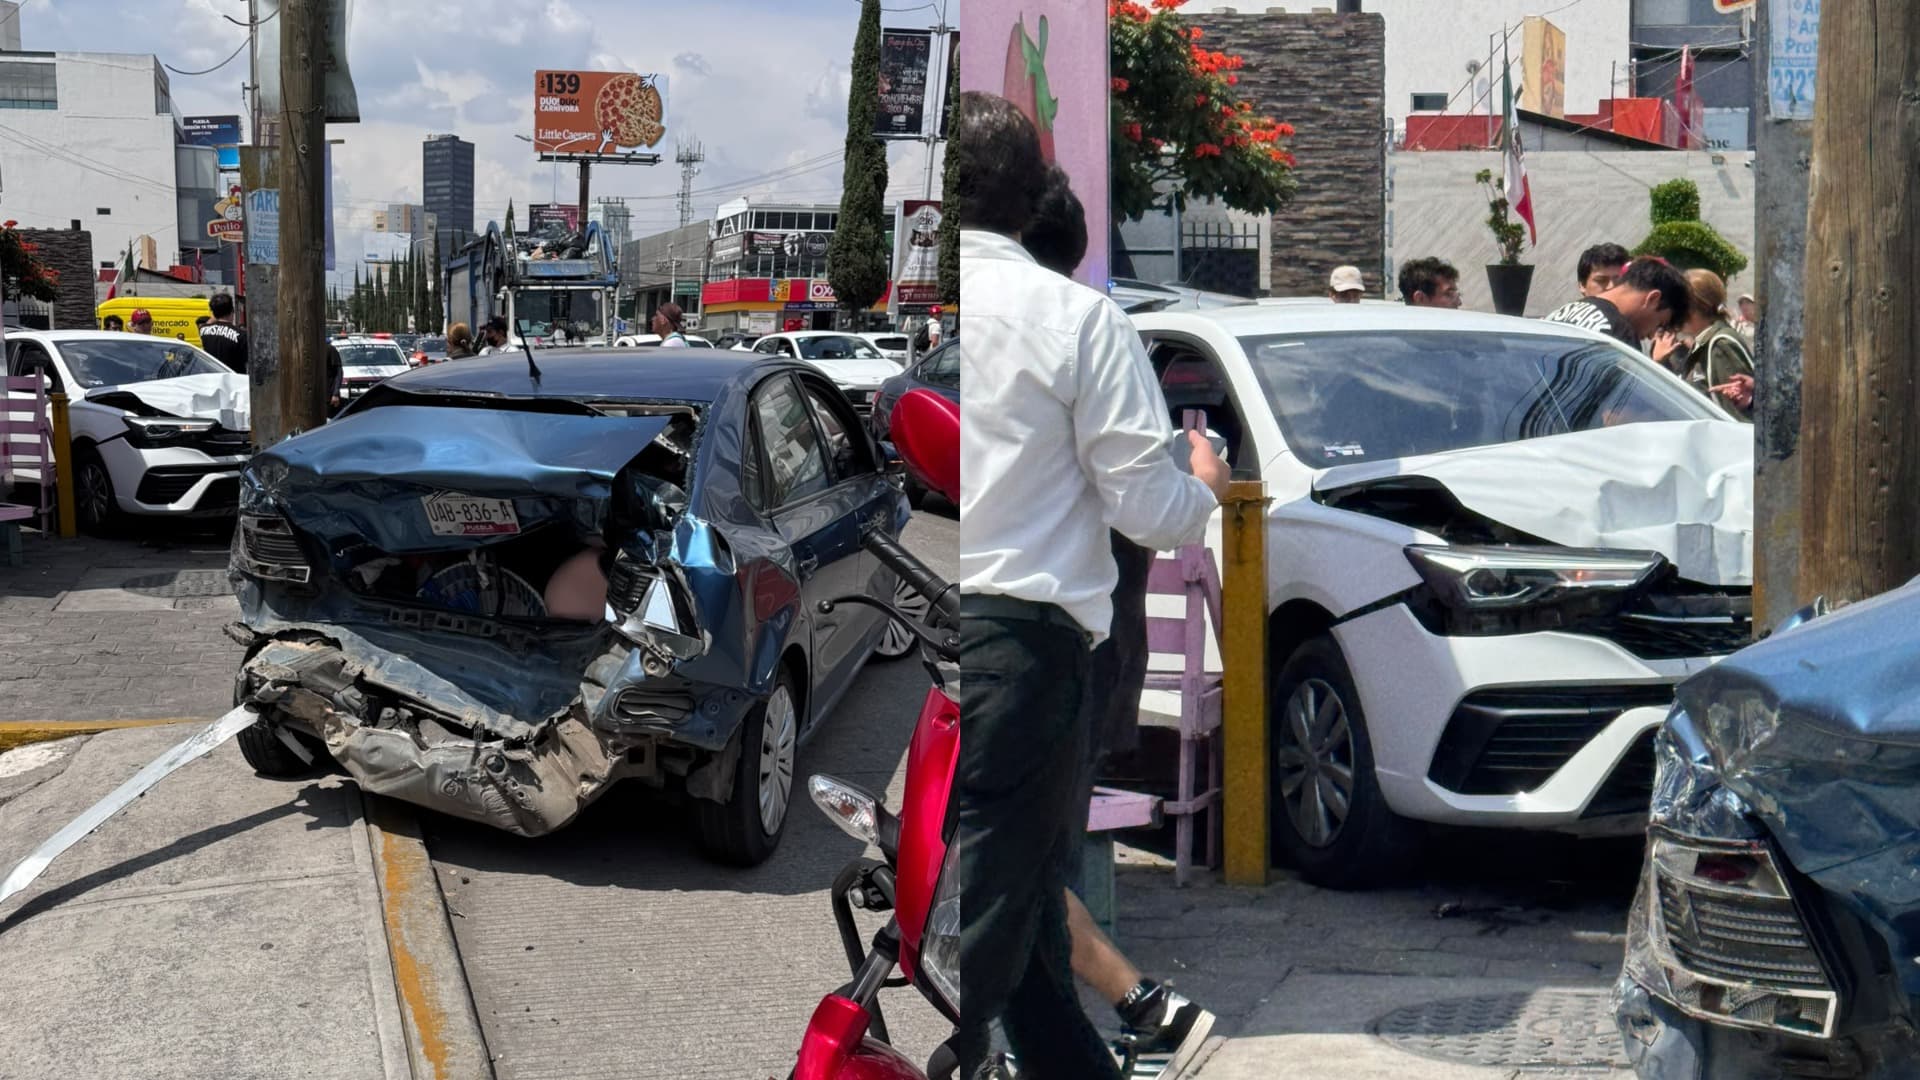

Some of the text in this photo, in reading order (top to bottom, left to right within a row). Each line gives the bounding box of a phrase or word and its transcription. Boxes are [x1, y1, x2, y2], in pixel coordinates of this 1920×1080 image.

[538, 128, 562, 140] Little
[1545, 301, 1612, 332] SHARK
[152, 326, 171, 334] libre
[426, 501, 512, 522] UAB-836-A
